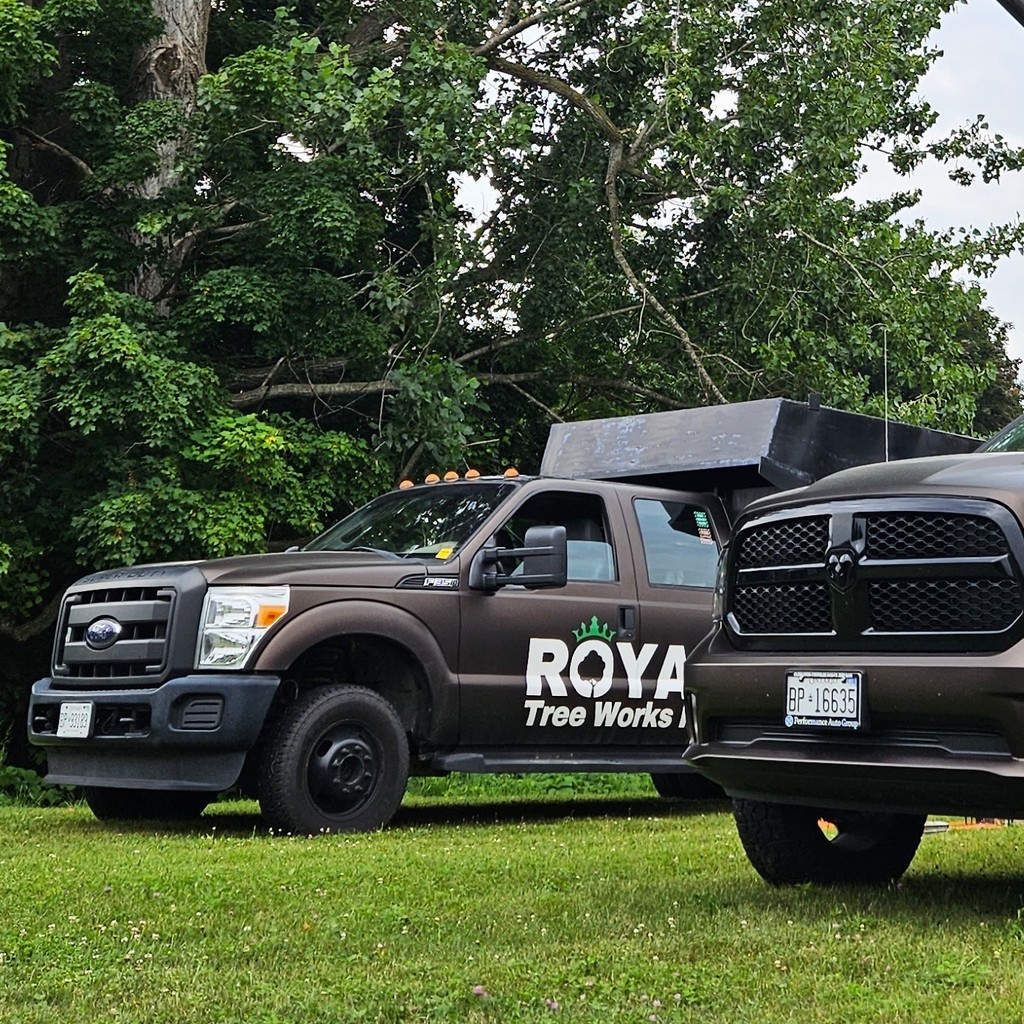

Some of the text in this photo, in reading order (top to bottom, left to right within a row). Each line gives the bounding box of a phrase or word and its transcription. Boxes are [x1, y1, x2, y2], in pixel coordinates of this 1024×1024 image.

[526, 637, 687, 701] ROYA
[524, 700, 587, 727] Tree
[594, 701, 674, 728] Works
[789, 687, 855, 714] BP 16635
